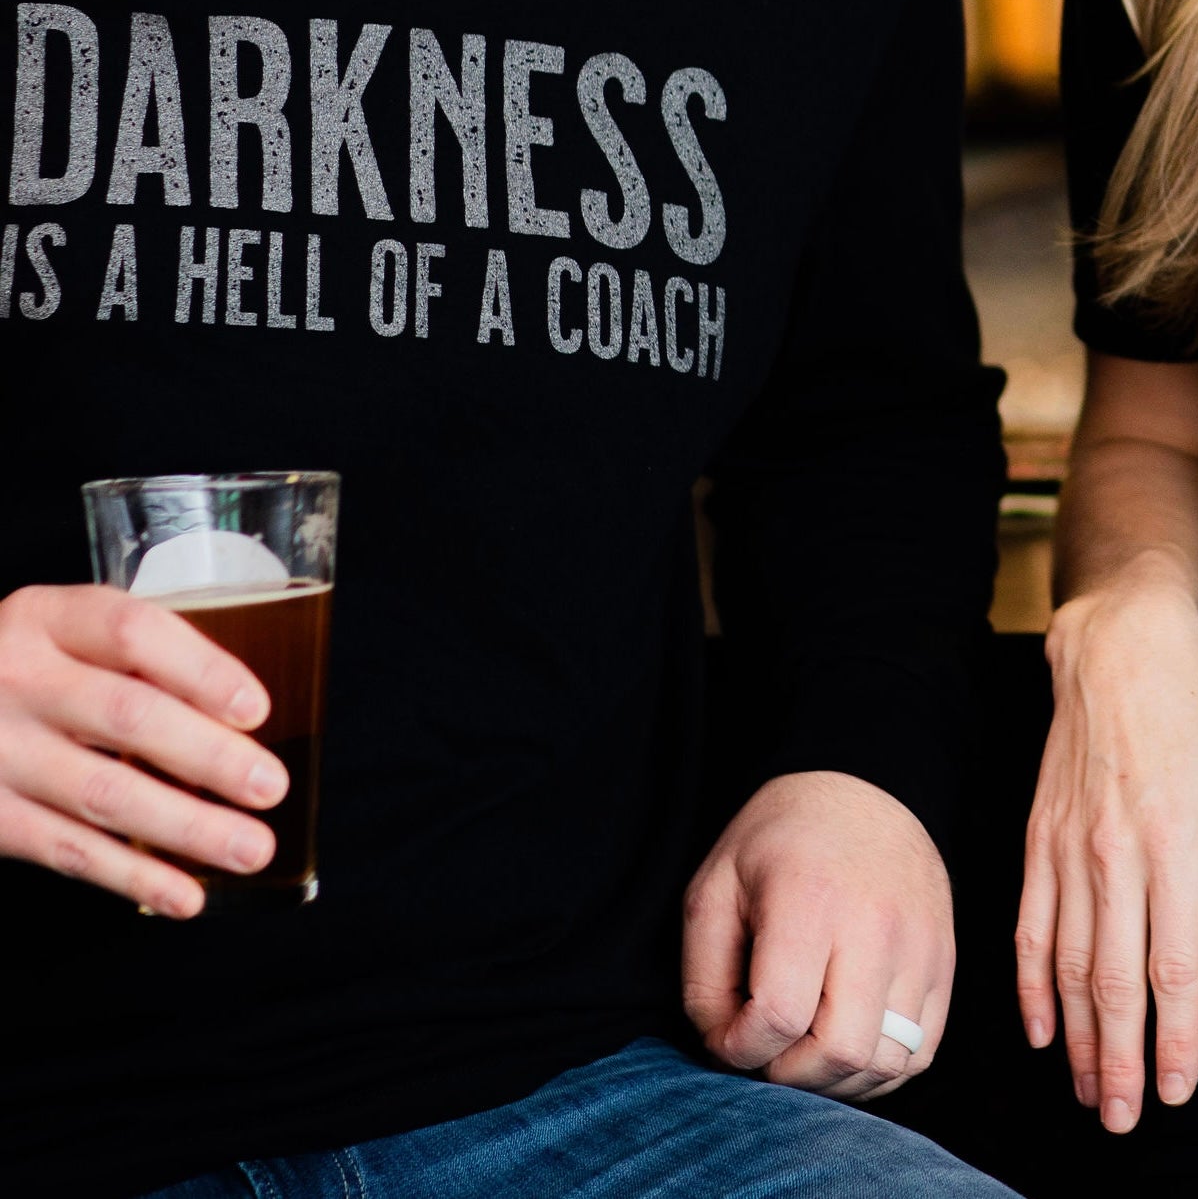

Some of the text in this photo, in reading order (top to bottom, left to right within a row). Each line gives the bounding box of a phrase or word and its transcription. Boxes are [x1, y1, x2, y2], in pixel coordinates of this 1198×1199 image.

[9, 2, 727, 264] DARKNESS
[0, 222, 726, 381] IS A HELL OF A COACH
